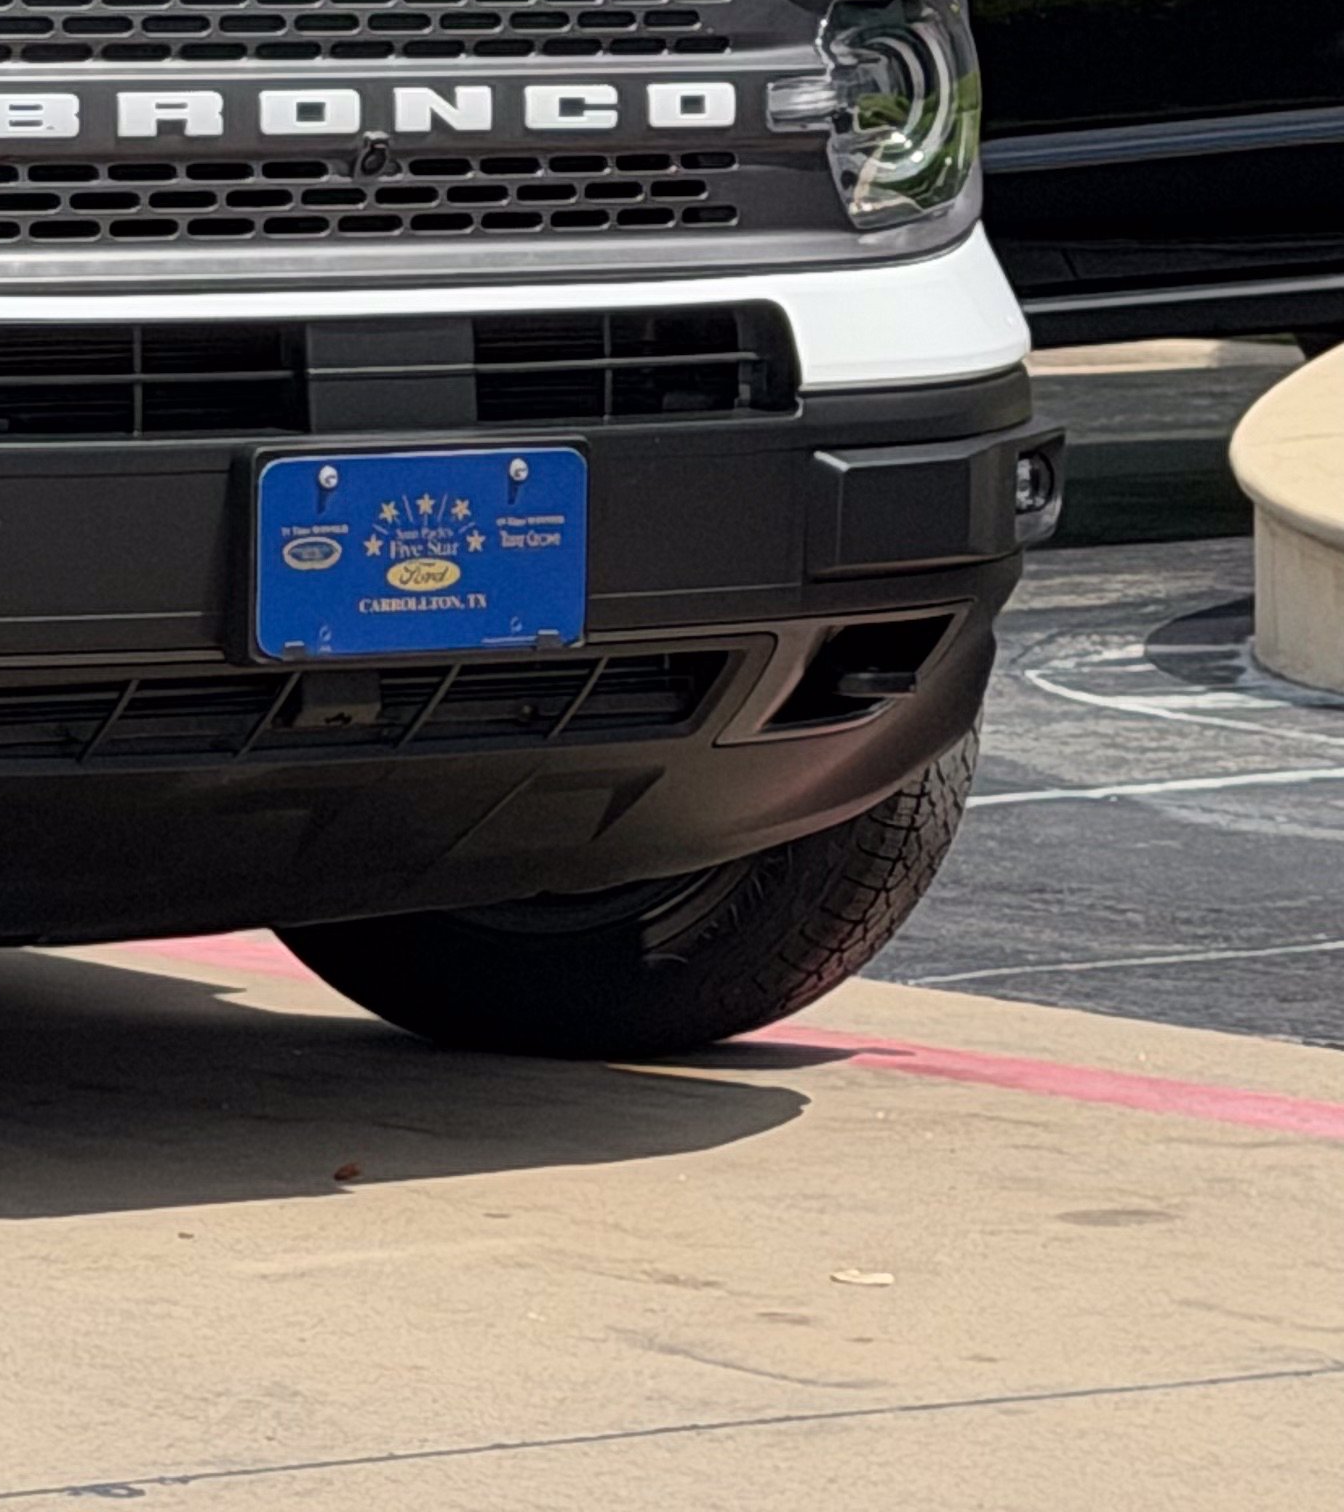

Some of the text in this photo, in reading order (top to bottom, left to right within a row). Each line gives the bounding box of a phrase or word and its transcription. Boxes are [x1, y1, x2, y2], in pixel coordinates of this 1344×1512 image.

[390, 538, 460, 560] Five Star
[399, 562, 450, 586] Ford
